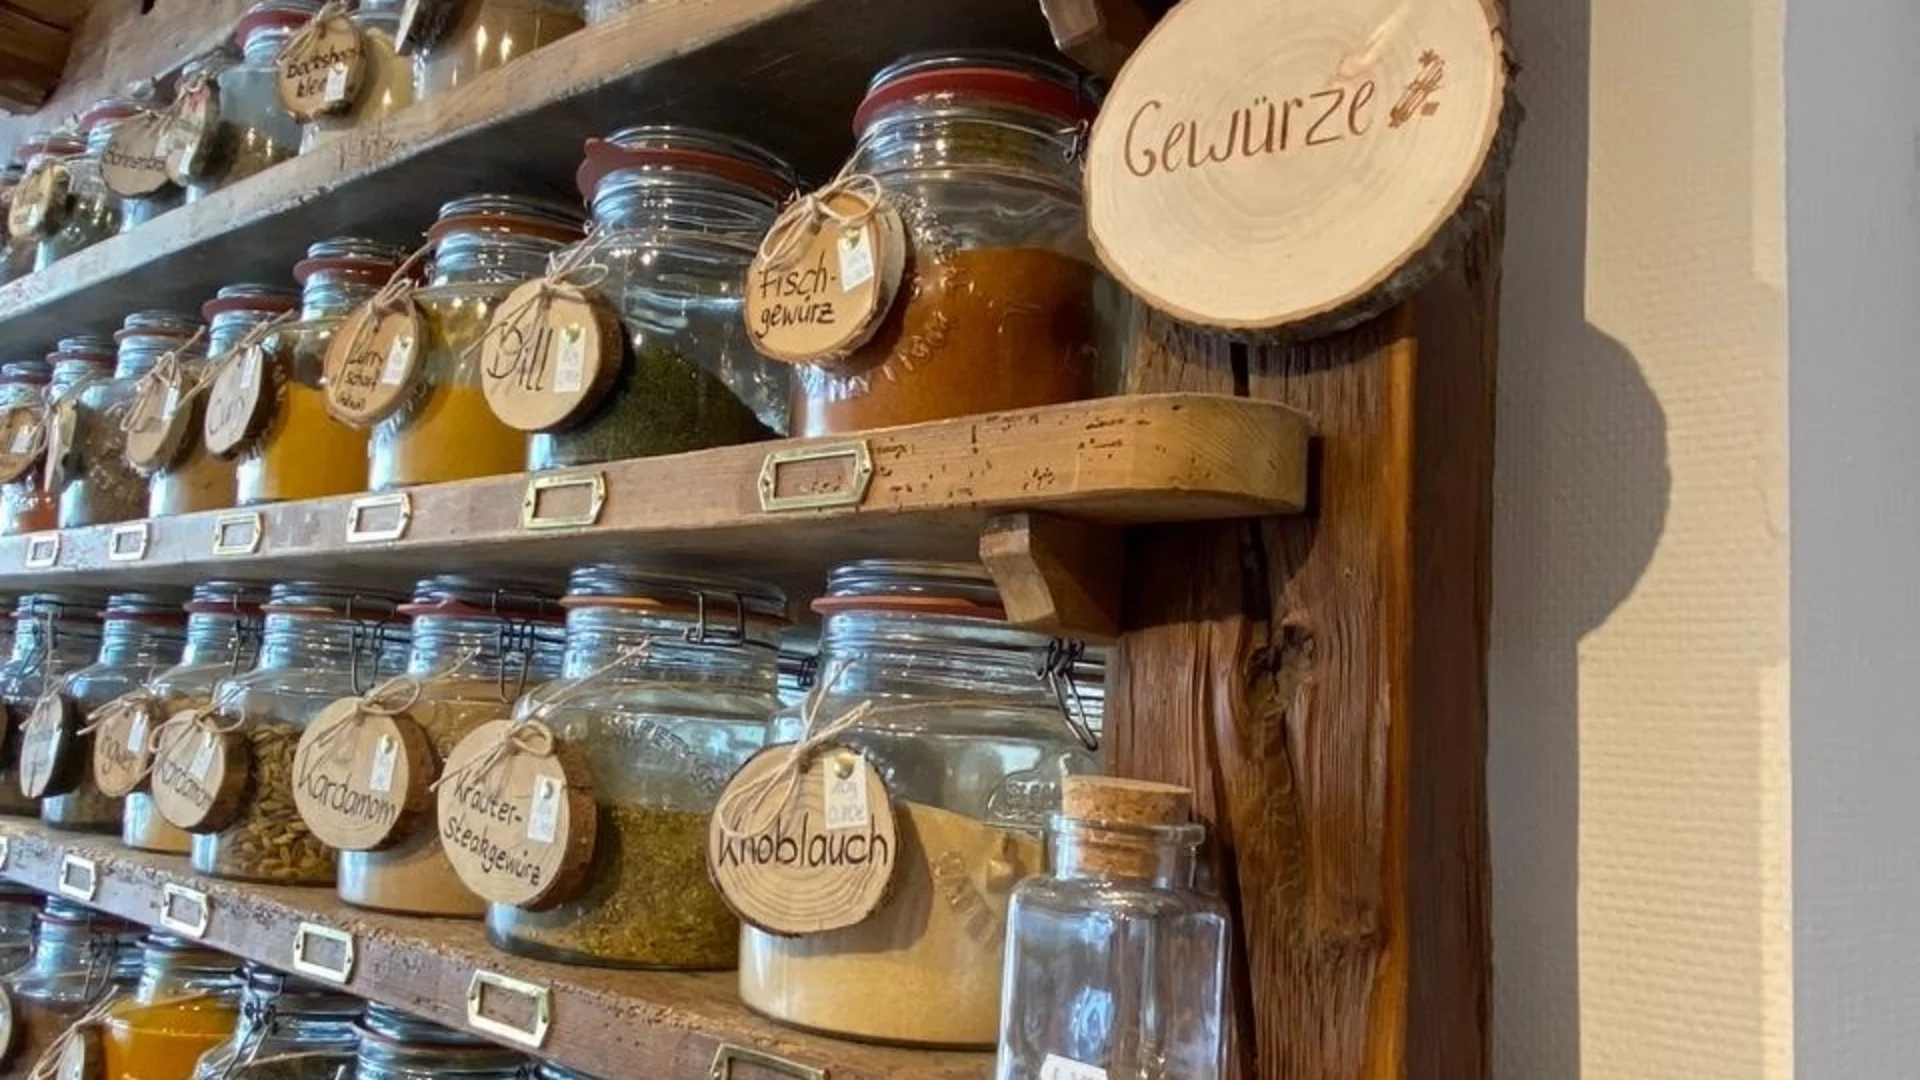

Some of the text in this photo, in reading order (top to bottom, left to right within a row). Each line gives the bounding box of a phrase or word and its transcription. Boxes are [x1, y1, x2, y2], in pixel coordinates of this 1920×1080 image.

[1124, 79, 1376, 177] Gewürze
[757, 251, 838, 300] Fisch-
[754, 295, 836, 338] gewürz
[486, 320, 555, 391] Dill
